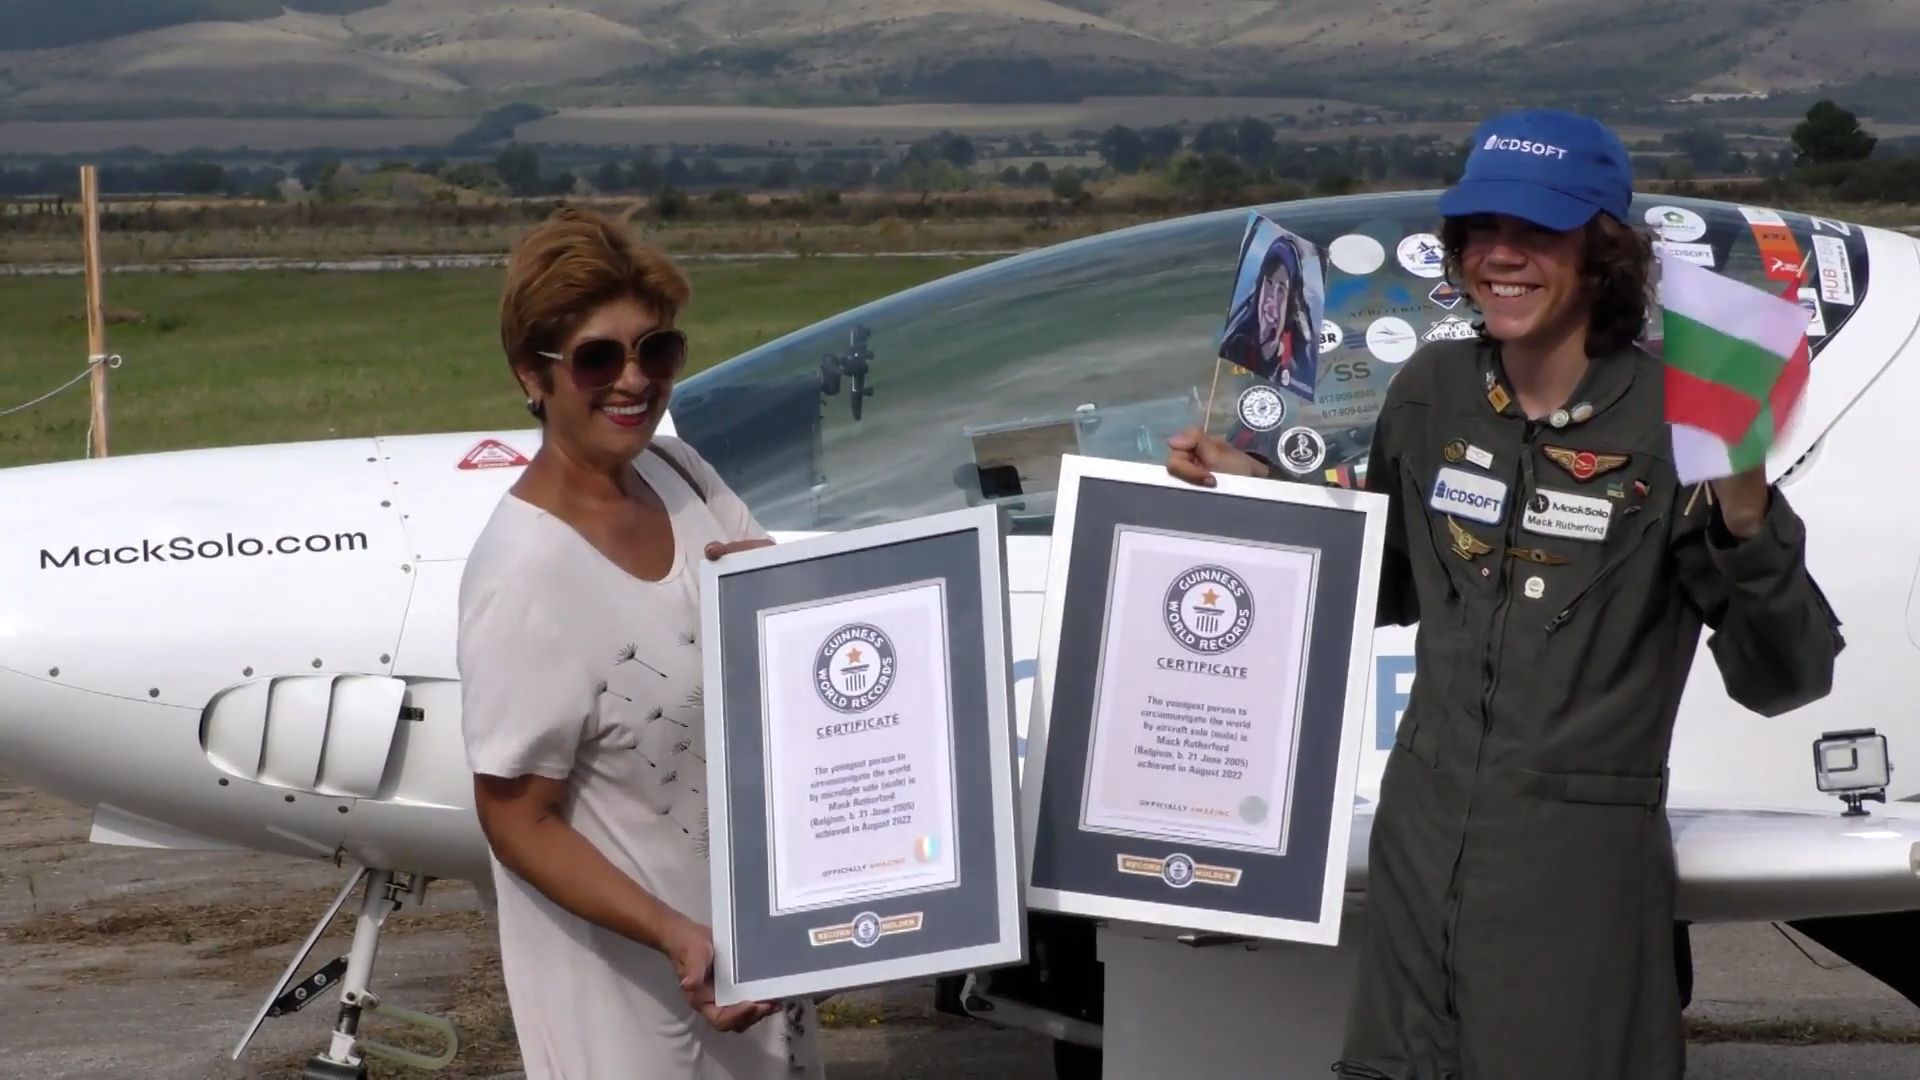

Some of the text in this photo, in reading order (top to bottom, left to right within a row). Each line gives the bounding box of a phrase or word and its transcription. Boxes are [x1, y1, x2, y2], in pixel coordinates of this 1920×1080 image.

[1495, 137, 1568, 160] ICDSOFT
[1823, 268, 1840, 300] HUB
[1445, 486, 1501, 512] ICDSOFT
[1552, 501, 1609, 518] MackSolo
[1527, 515, 1605, 535] Mack Rutherford
[39, 530, 368, 570] MackSolo.com
[1179, 570, 1245, 598] GUINNESS
[1168, 600, 1250, 650] WORLD RECORDS
[824, 628, 884, 657] GUINNESS
[1157, 657, 1248, 679] CERTIFICATE
[817, 657, 893, 708] WORLD RECORDS
[1148, 696, 1163, 706] The
[1207, 704, 1236, 716] person
[816, 713, 900, 738] CERTIFICATE
[1226, 718, 1251, 729] world
[1156, 735, 1230, 753] Mack Rutherford
[1189, 765, 1220, 778] August
